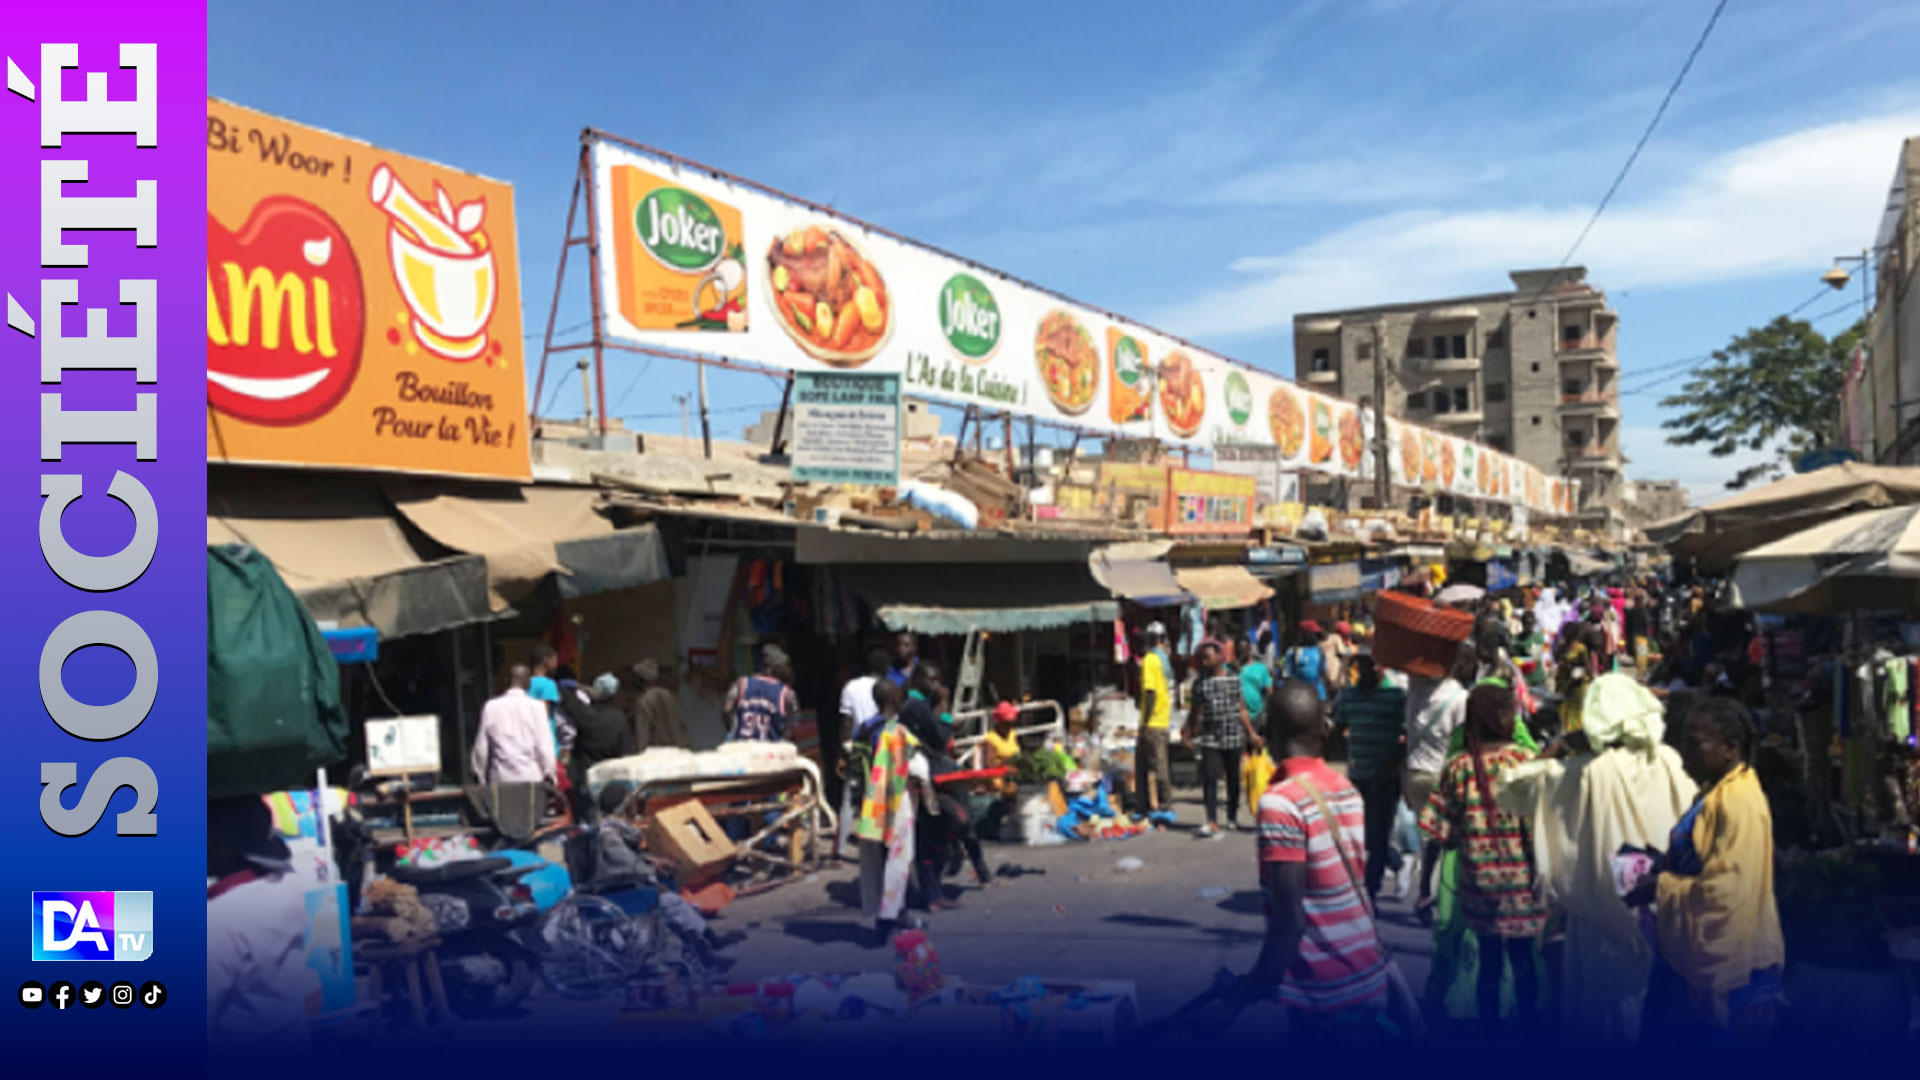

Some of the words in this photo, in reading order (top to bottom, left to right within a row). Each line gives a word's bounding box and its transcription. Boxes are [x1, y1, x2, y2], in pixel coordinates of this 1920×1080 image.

[207, 115, 242, 153] Bi
[248, 128, 334, 176] Woor
[647, 196, 719, 255] Joker
[945, 287, 998, 341] Joker
[395, 371, 494, 411] Bouillon
[940, 361, 956, 391] de
[372, 406, 433, 438] Pour
[438, 415, 460, 442] la
[464, 415, 502, 446] Vie
